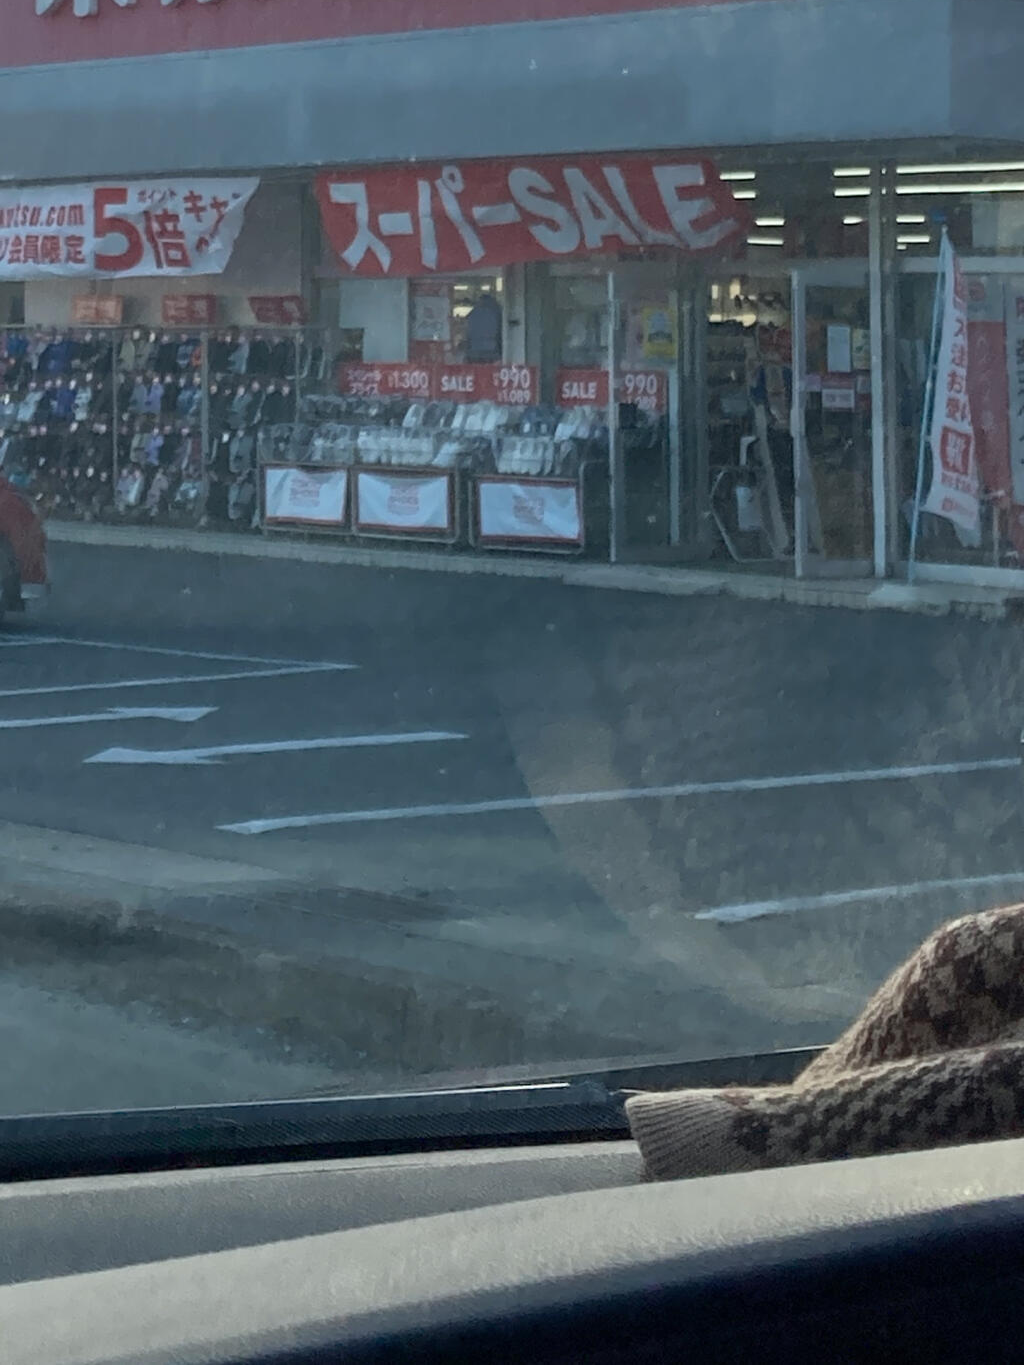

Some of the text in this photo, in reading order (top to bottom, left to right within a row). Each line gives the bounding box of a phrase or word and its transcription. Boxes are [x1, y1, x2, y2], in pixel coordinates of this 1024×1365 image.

[328, 165, 739, 274] スーパーSALE
[441, 375, 475, 392] SALE
[562, 381, 597, 399] SALE
